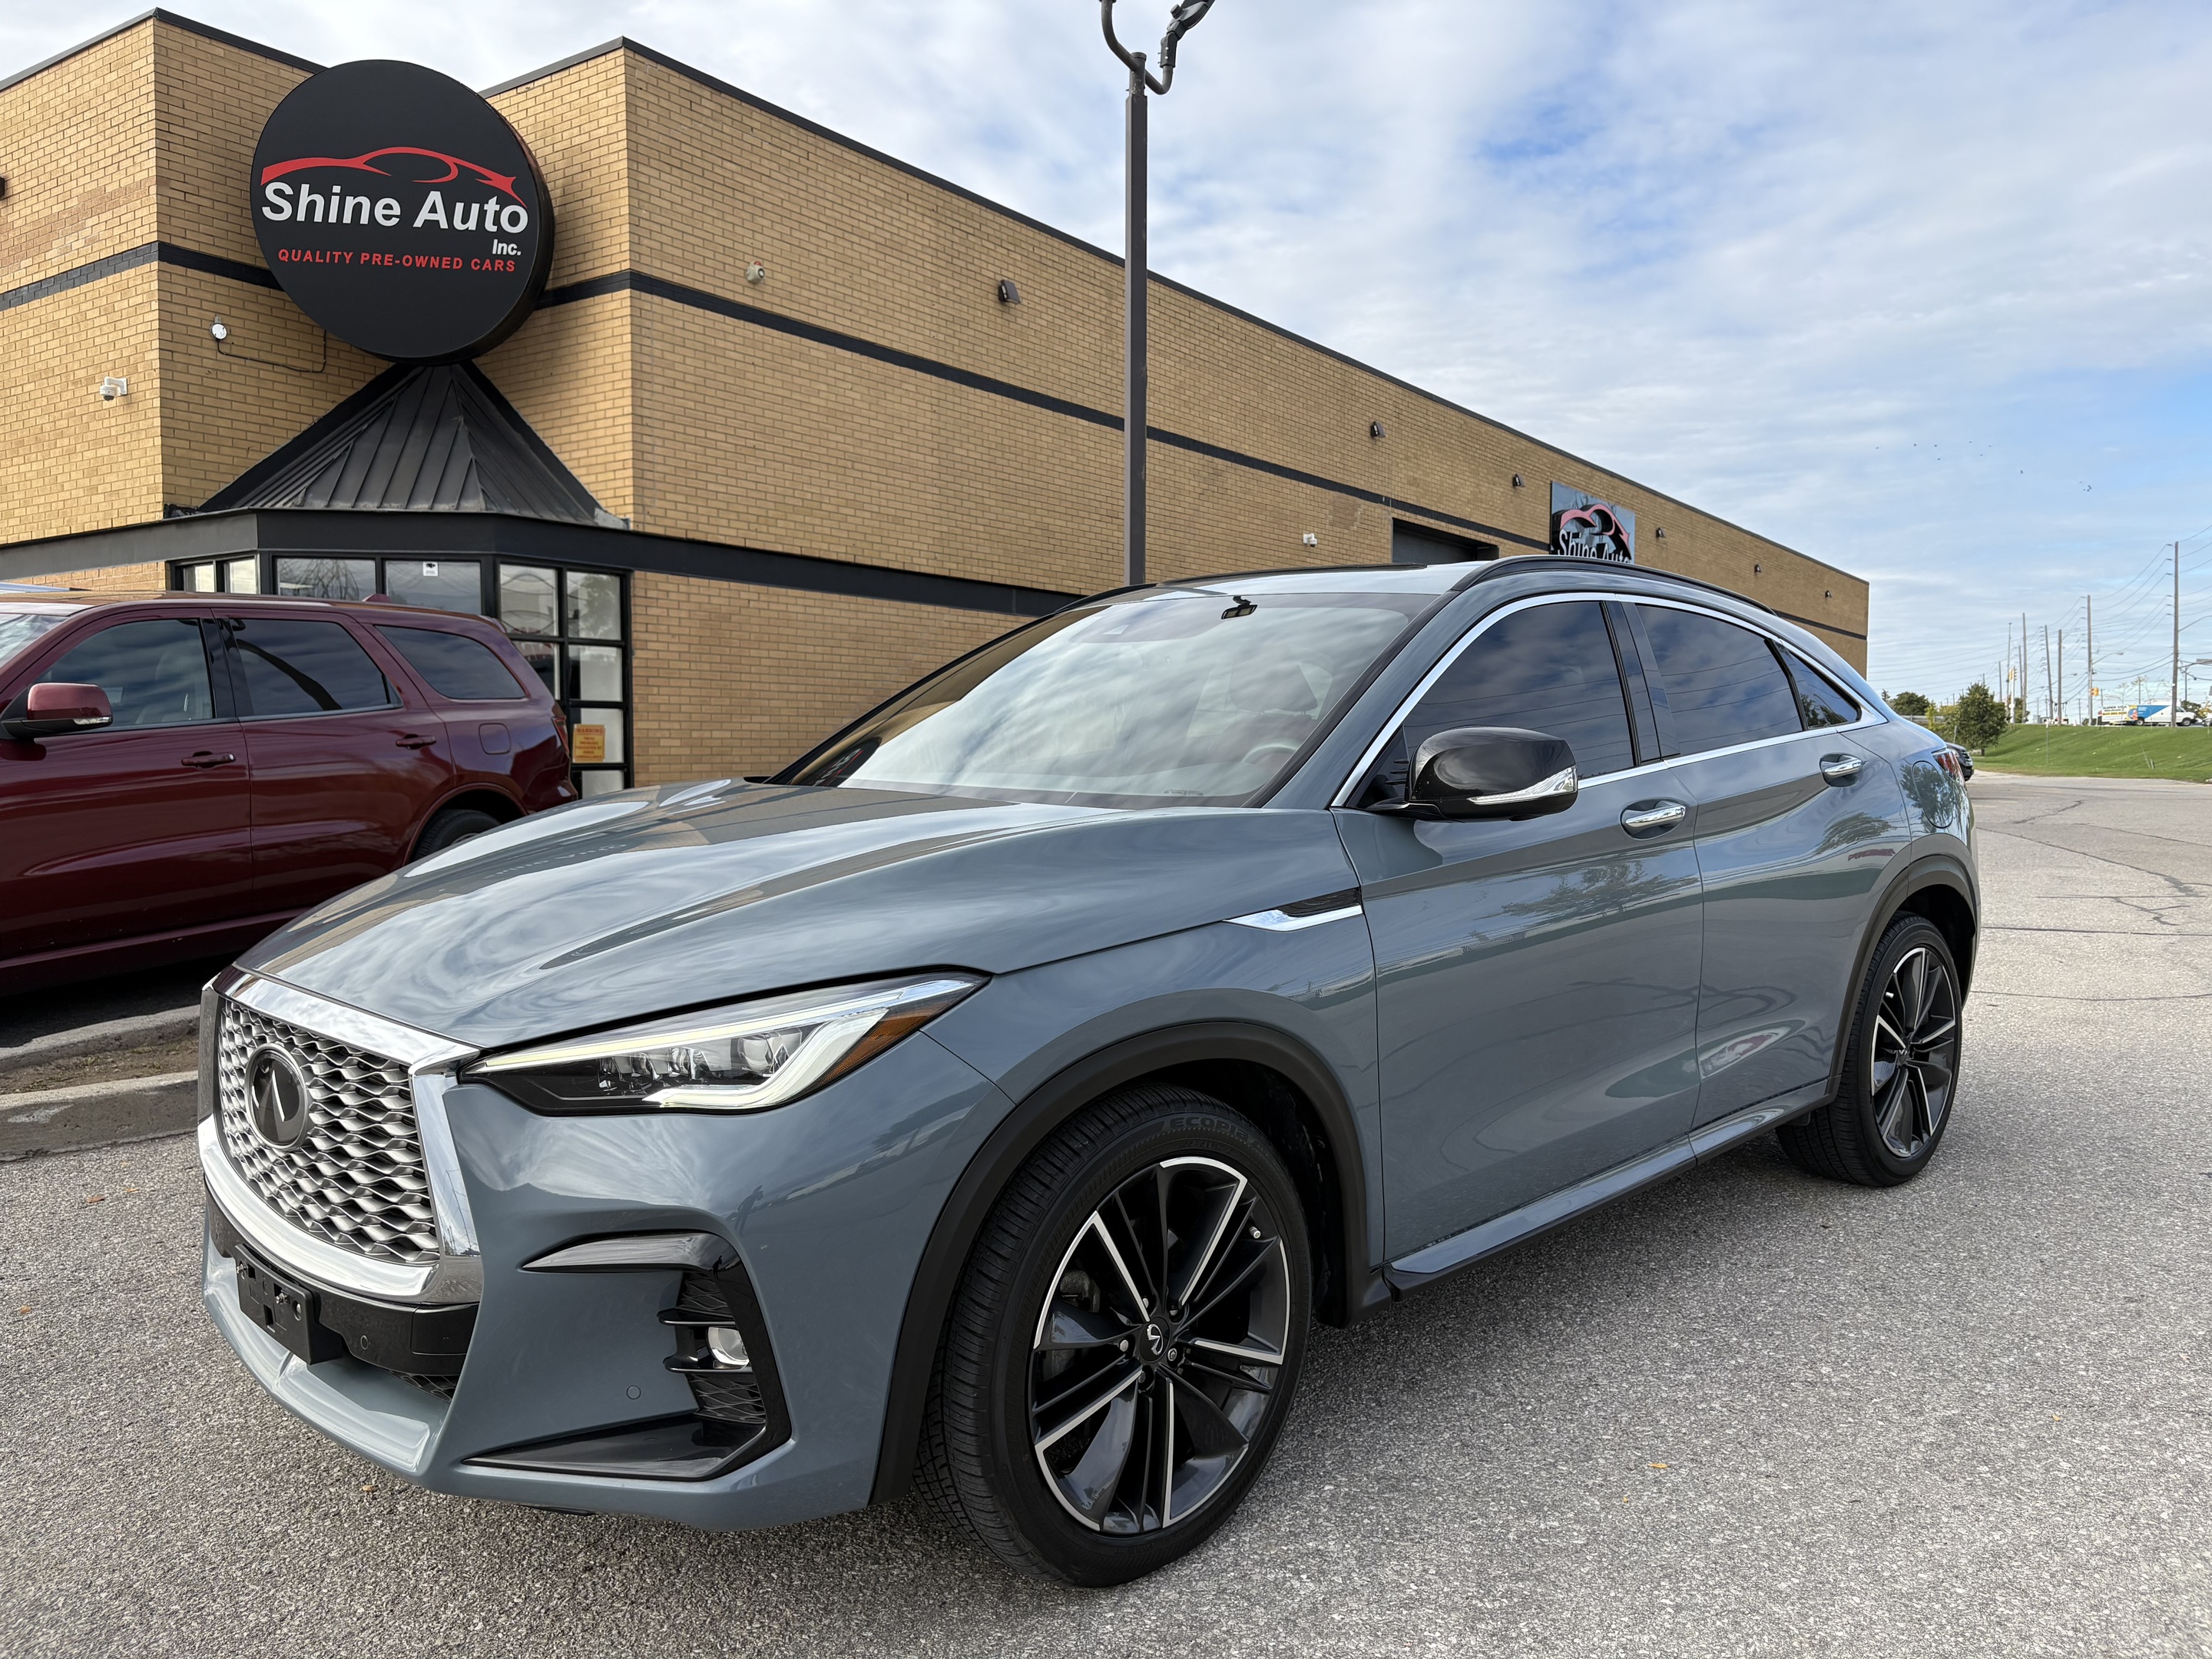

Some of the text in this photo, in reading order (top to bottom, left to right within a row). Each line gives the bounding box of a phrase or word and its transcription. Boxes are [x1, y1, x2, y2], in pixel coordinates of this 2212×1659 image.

[261, 181, 529, 234] Shine Auto
[277, 248, 516, 273] QUALITY PRE-OWNED CARS
[492, 239, 522, 257] Inc.
